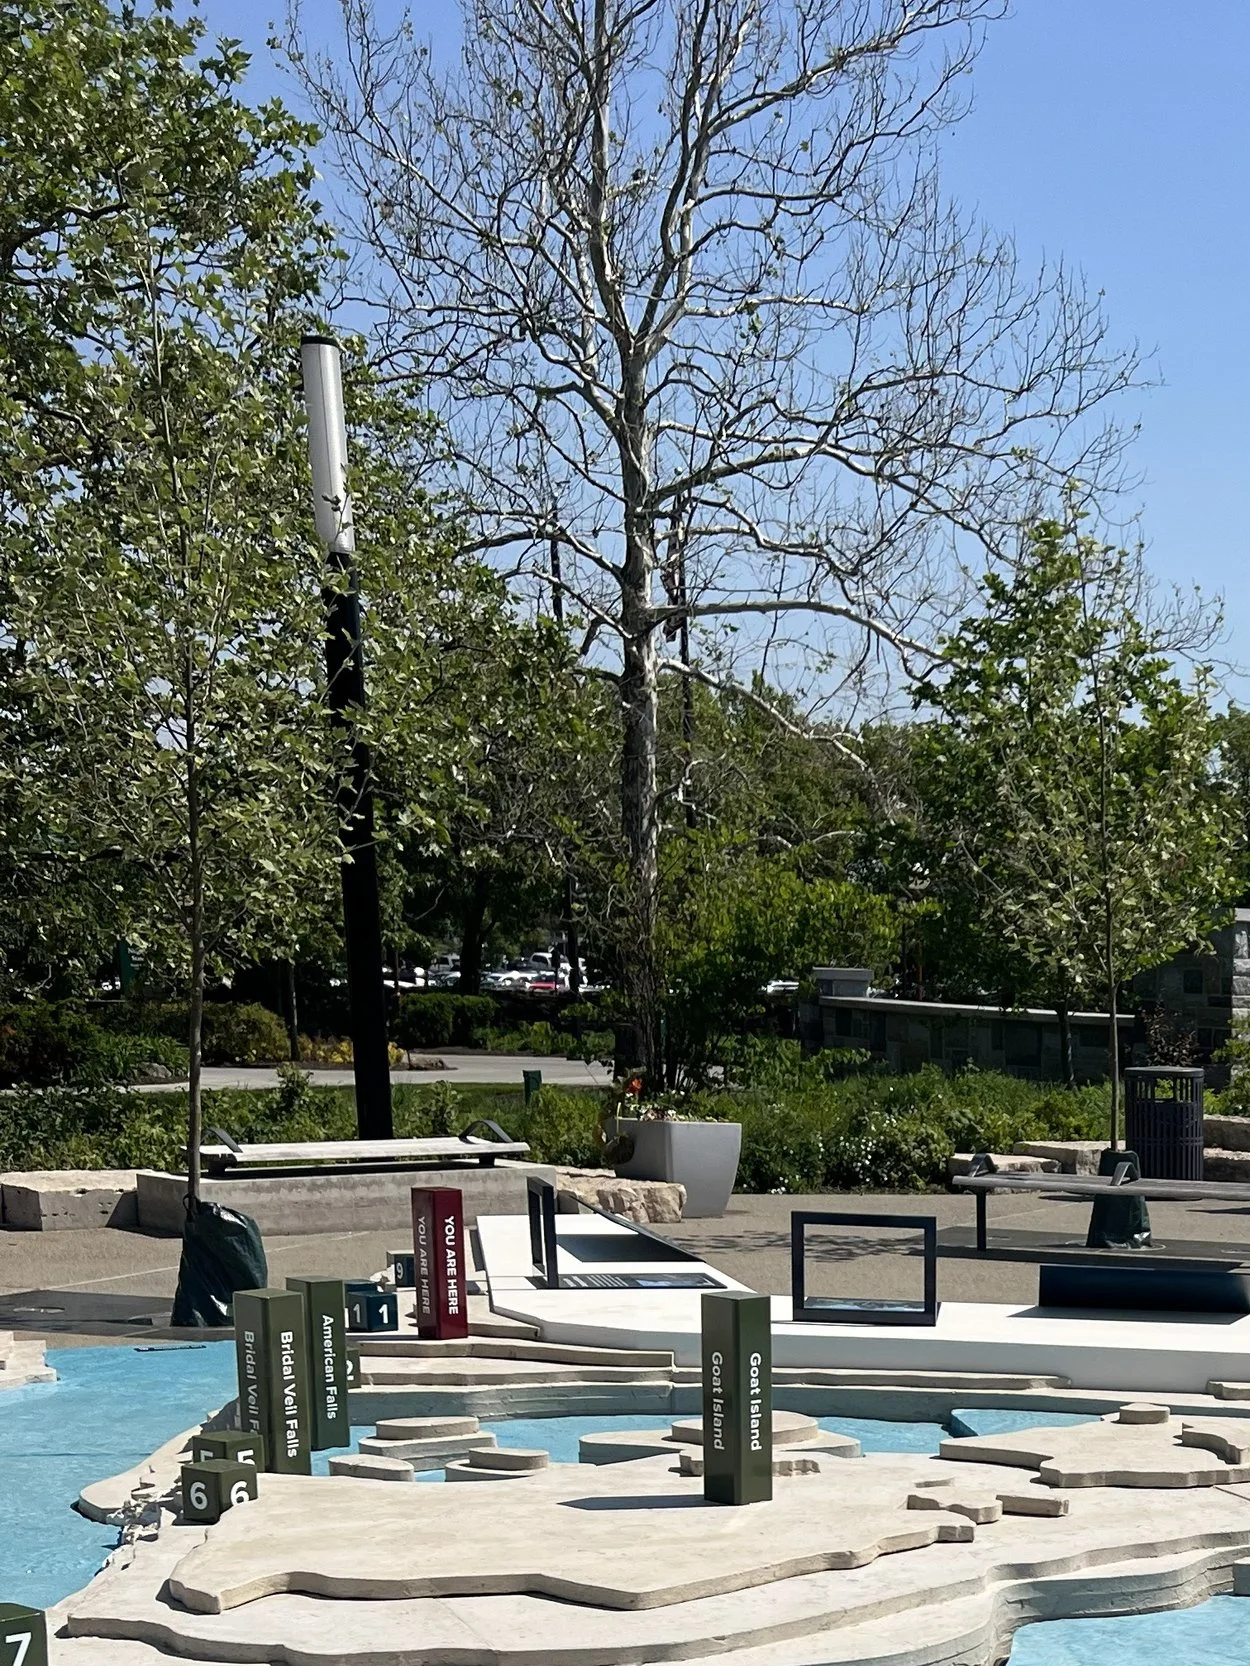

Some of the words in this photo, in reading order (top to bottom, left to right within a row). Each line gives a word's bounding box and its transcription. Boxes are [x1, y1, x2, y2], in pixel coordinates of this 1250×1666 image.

[418, 1216, 426, 1245] YOU
[445, 1216, 456, 1246] YOU
[396, 1262, 404, 1279] 9
[420, 1249, 428, 1278] ARE
[446, 1249, 457, 1276] ARE
[421, 1279, 430, 1314] HERE
[448, 1279, 458, 1315] HERE
[353, 1304, 361, 1323] 1
[379, 1304, 389, 1324] 1
[244, 1331, 257, 1380] Bridal
[280, 1331, 295, 1380] Bridal
[322, 1315, 338, 1382] American
[711, 1351, 723, 1394] Goat
[750, 1352, 761, 1395] Goat
[248, 1384, 259, 1415] Veil
[284, 1384, 297, 1415] Veil
[325, 1386, 338, 1420] Falls
[286, 1418, 299, 1458] Falls
[713, 1398, 725, 1450] Island
[750, 1399, 762, 1451] Island
[190, 1481, 208, 1510] 6
[230, 1480, 250, 1506] 6
